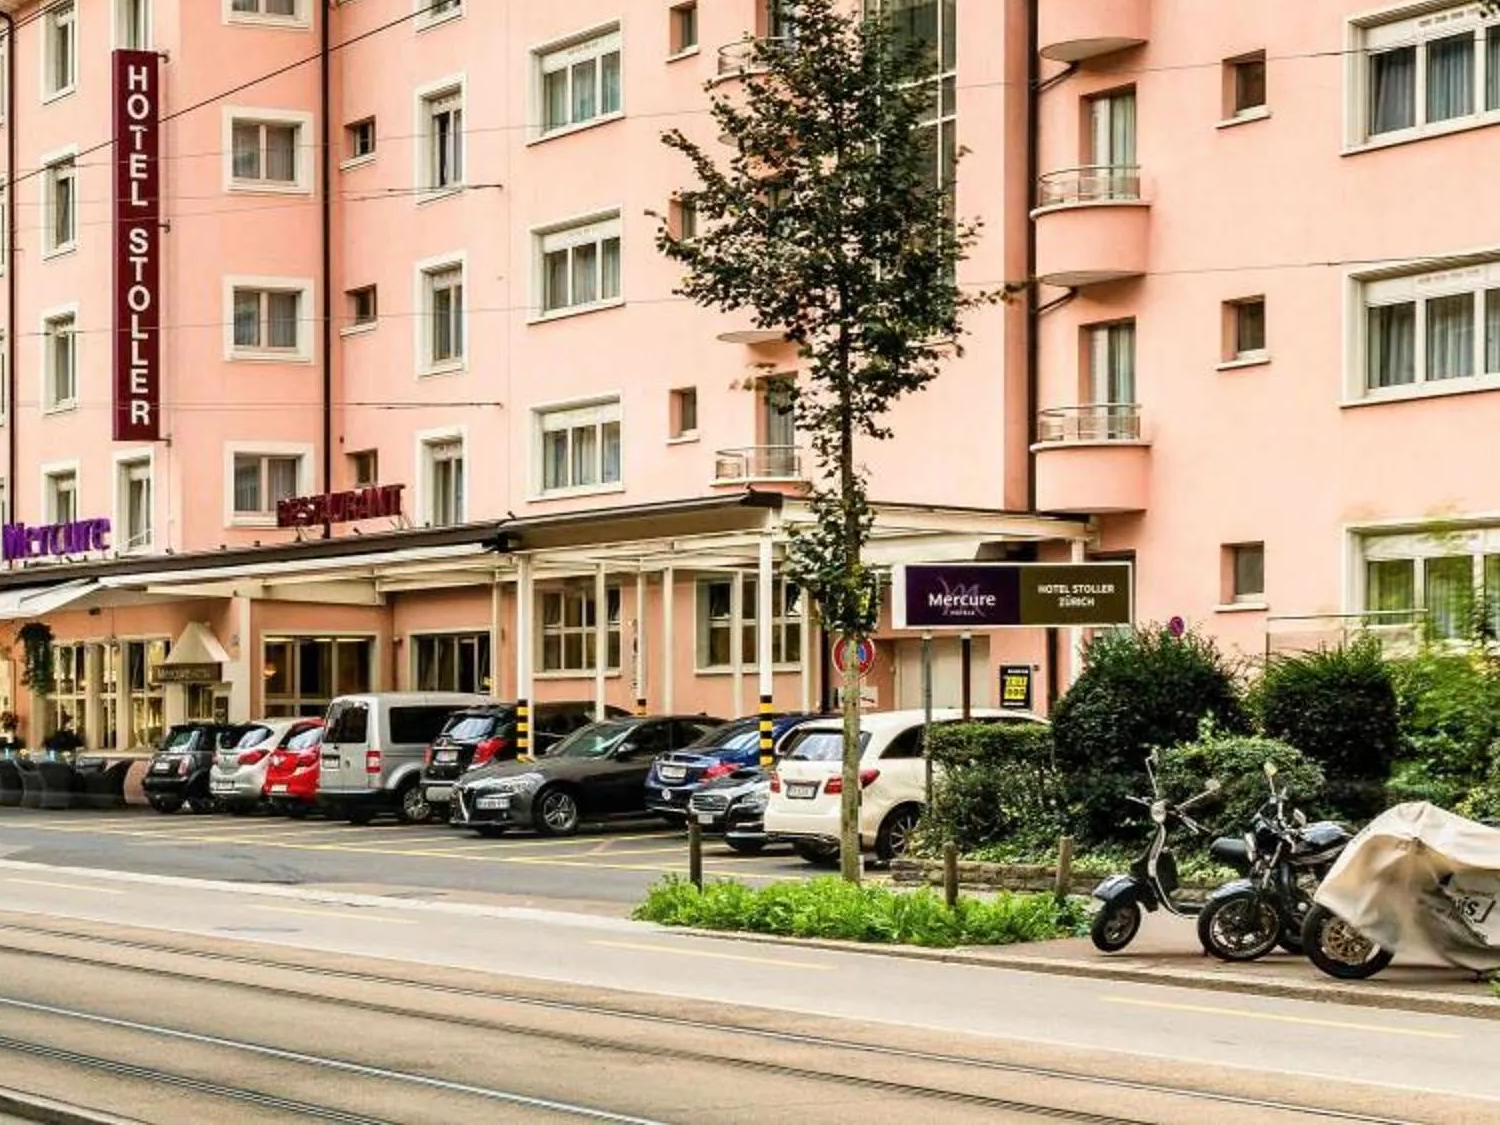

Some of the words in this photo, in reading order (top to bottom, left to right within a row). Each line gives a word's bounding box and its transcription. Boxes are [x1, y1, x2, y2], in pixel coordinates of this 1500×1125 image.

[127, 65, 149, 207] HOTEL
[127, 228, 151, 425] STOLLER
[277, 484, 405, 527] RESTAURANT
[2, 518, 111, 560] Mercure
[928, 593, 997, 608] Mercure
[1037, 584, 1070, 594] HOTEL
[1072, 583, 1115, 594] STOLLER
[1057, 596, 1095, 607] ZÜRICH
